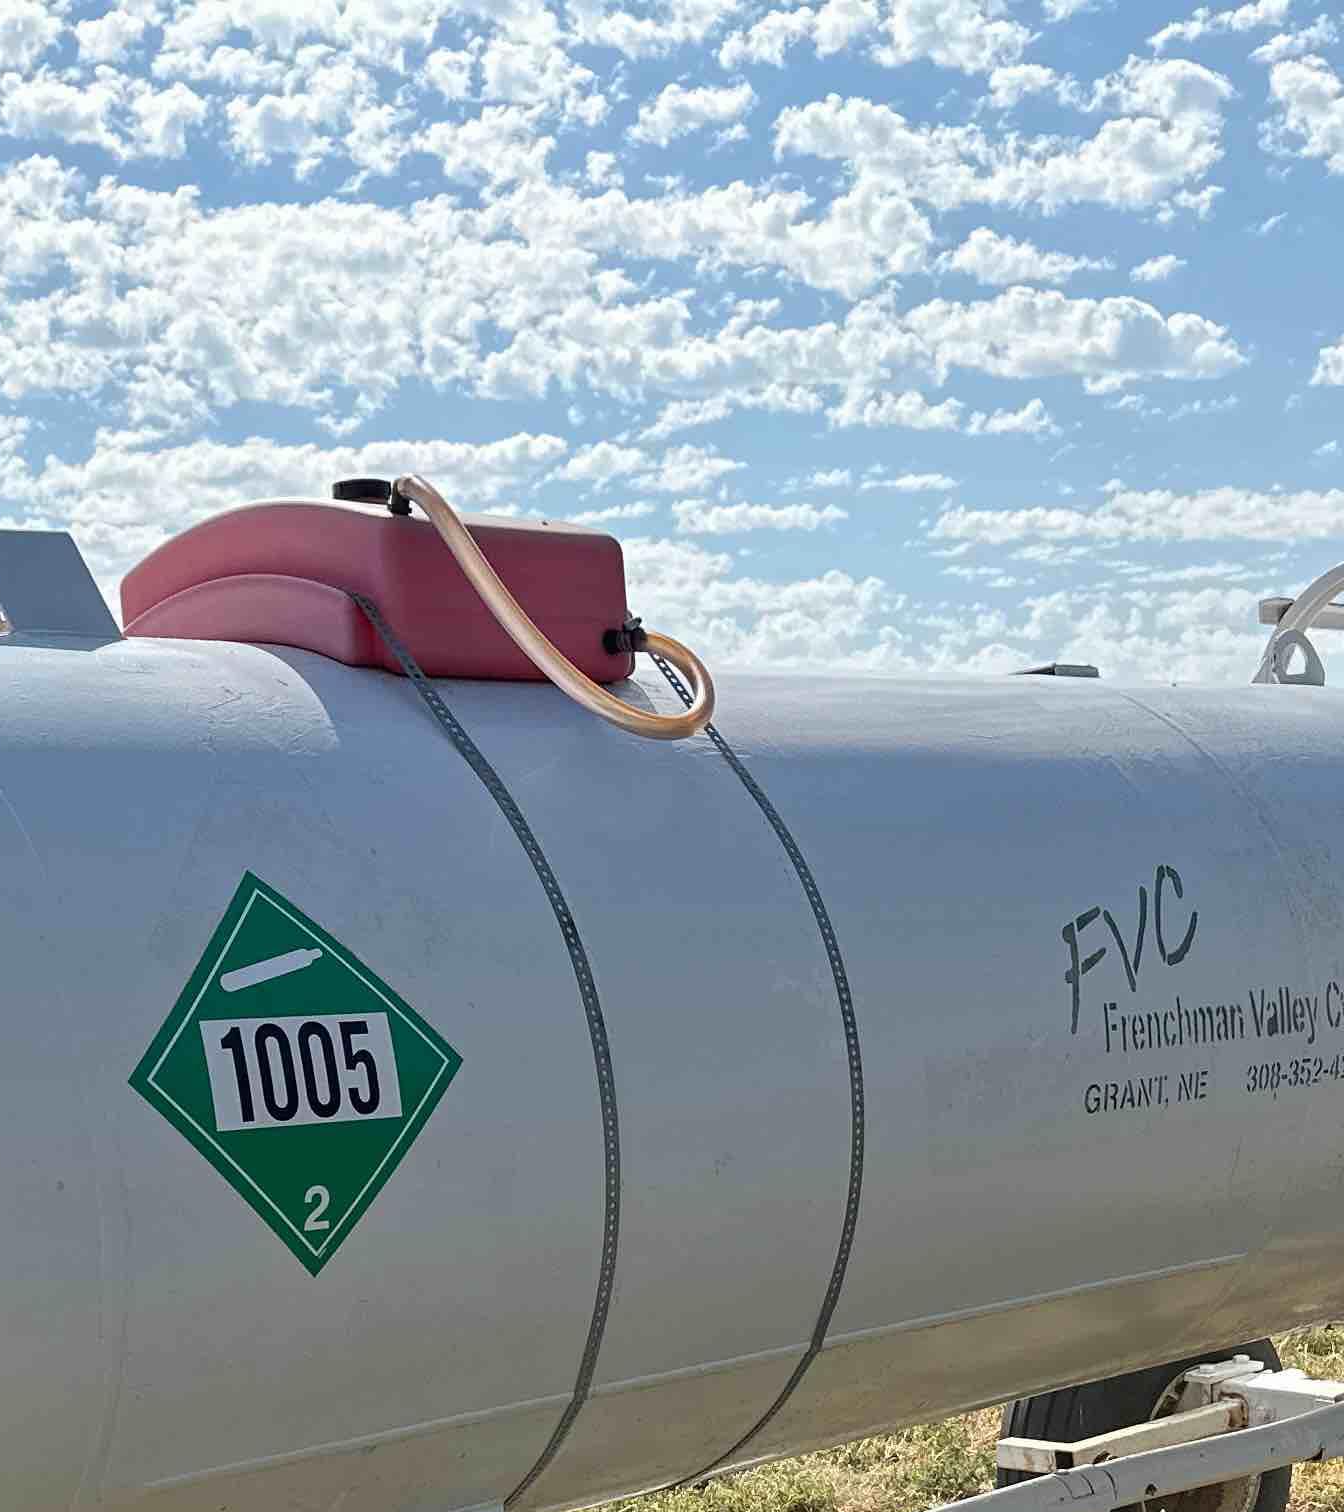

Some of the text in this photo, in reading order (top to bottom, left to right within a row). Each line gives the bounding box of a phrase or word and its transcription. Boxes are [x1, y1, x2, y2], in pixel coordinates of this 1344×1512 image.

[1062, 865, 1198, 1035] FVC
[1103, 997, 1246, 1053] Frenchman
[1249, 986, 1319, 1044] Valley
[219, 1020, 382, 1123] 1005
[1084, 1074, 1169, 1114] GRANT,
[1177, 1069, 1209, 1102] NE
[303, 1184, 330, 1232] 2
